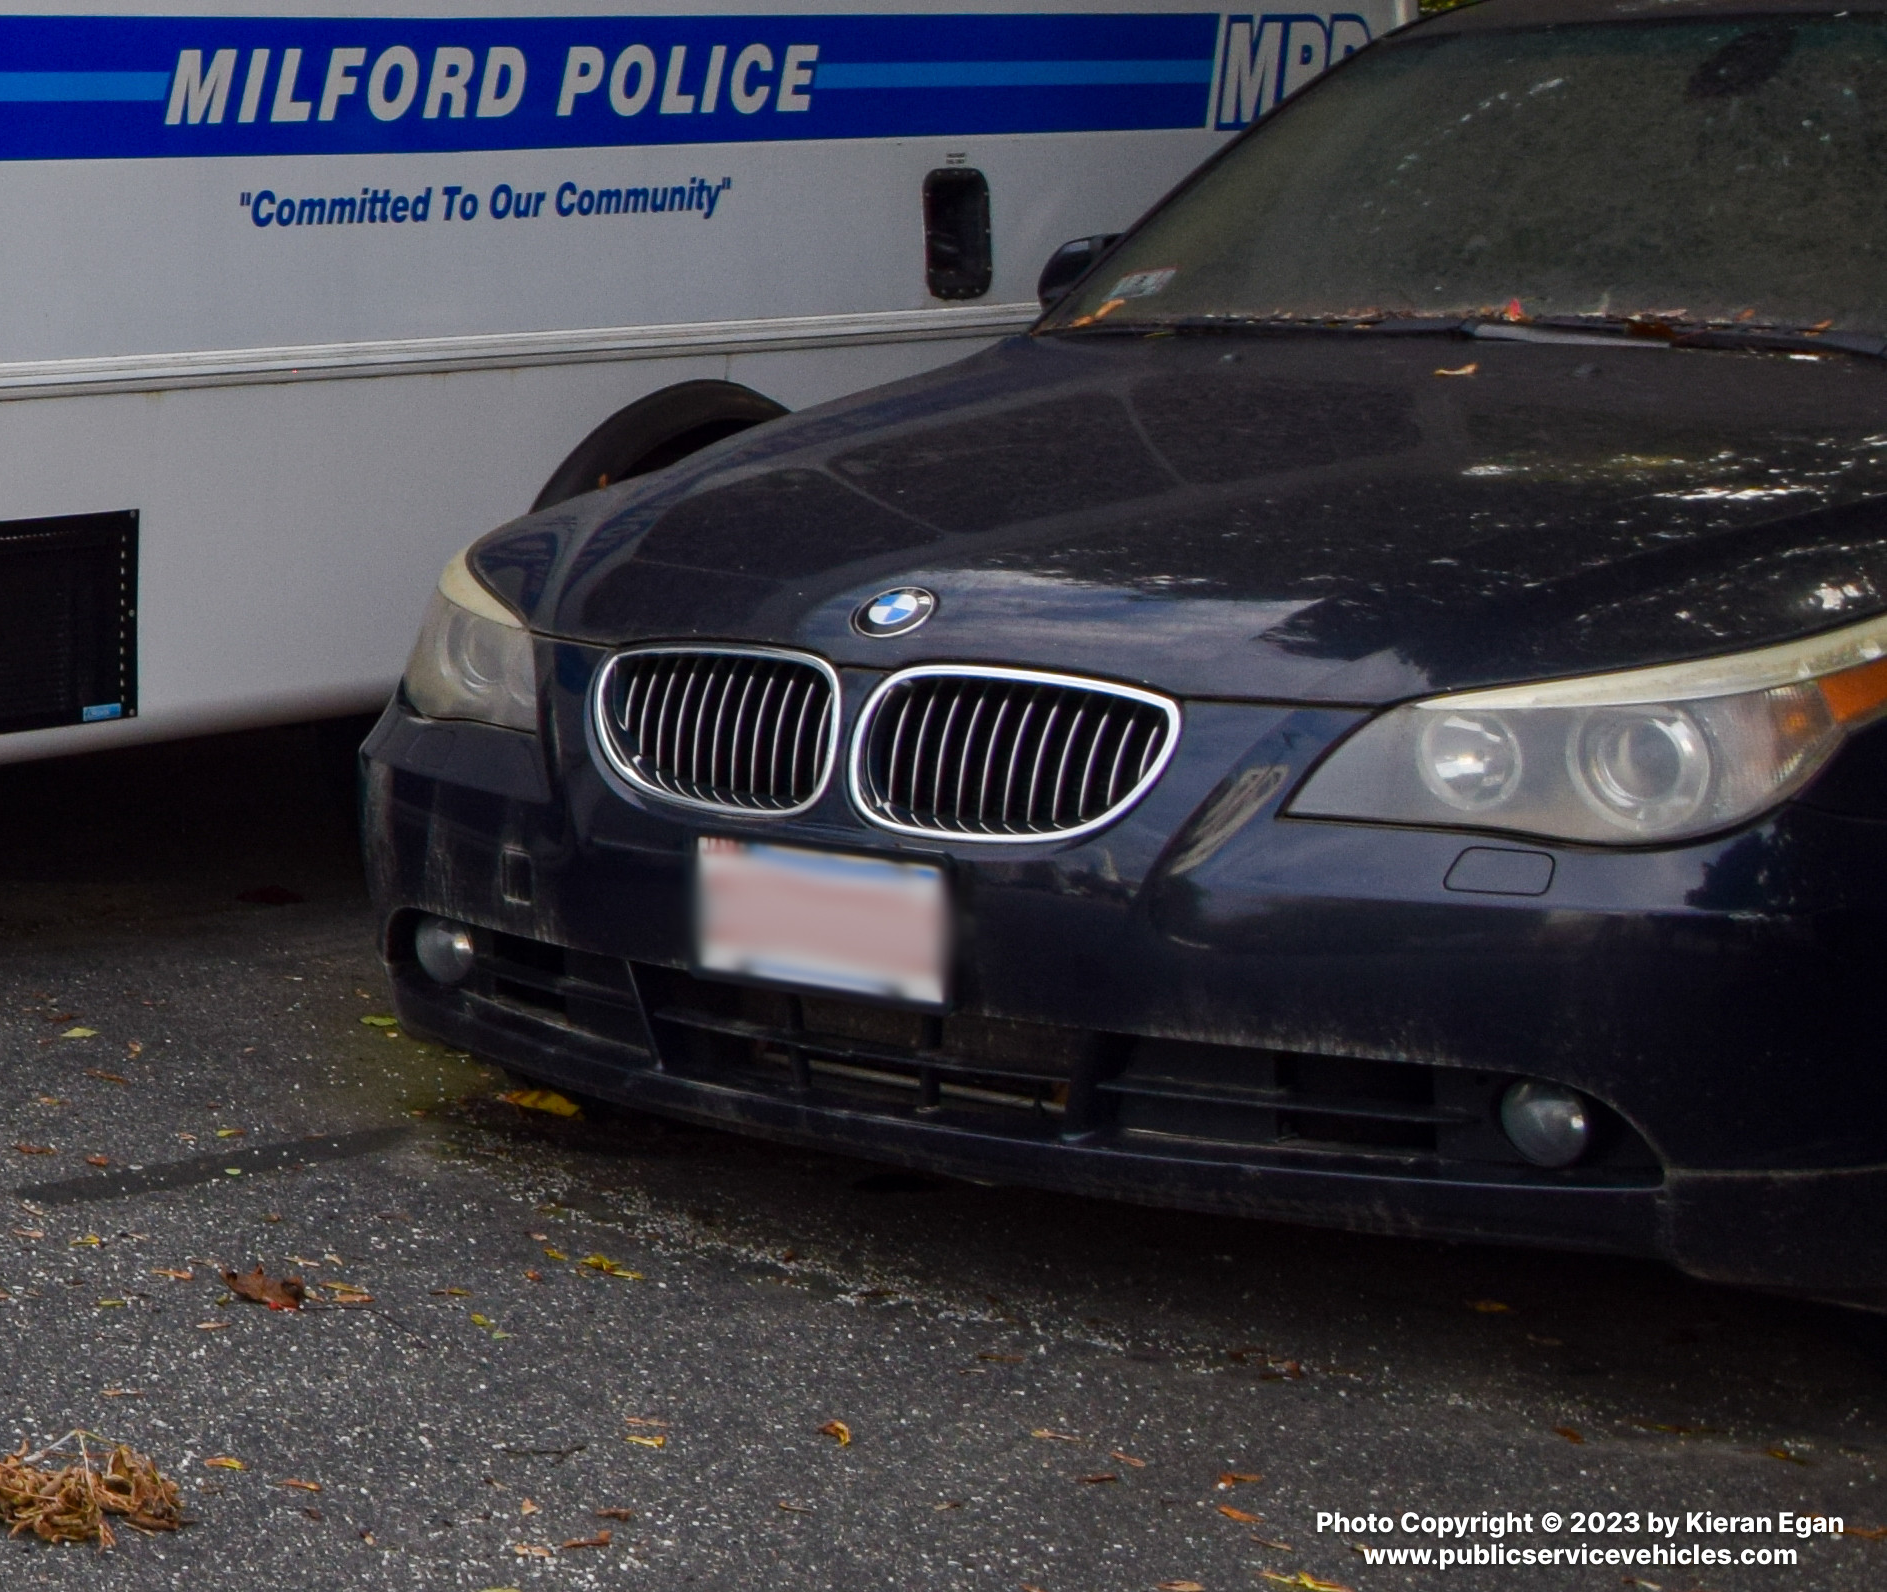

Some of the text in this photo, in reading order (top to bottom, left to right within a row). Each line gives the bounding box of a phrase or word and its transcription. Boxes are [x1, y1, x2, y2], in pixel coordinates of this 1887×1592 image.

[165, 43, 819, 125] MILFORD POLICE
[239, 176, 732, 228] "Committed To Our Community"
